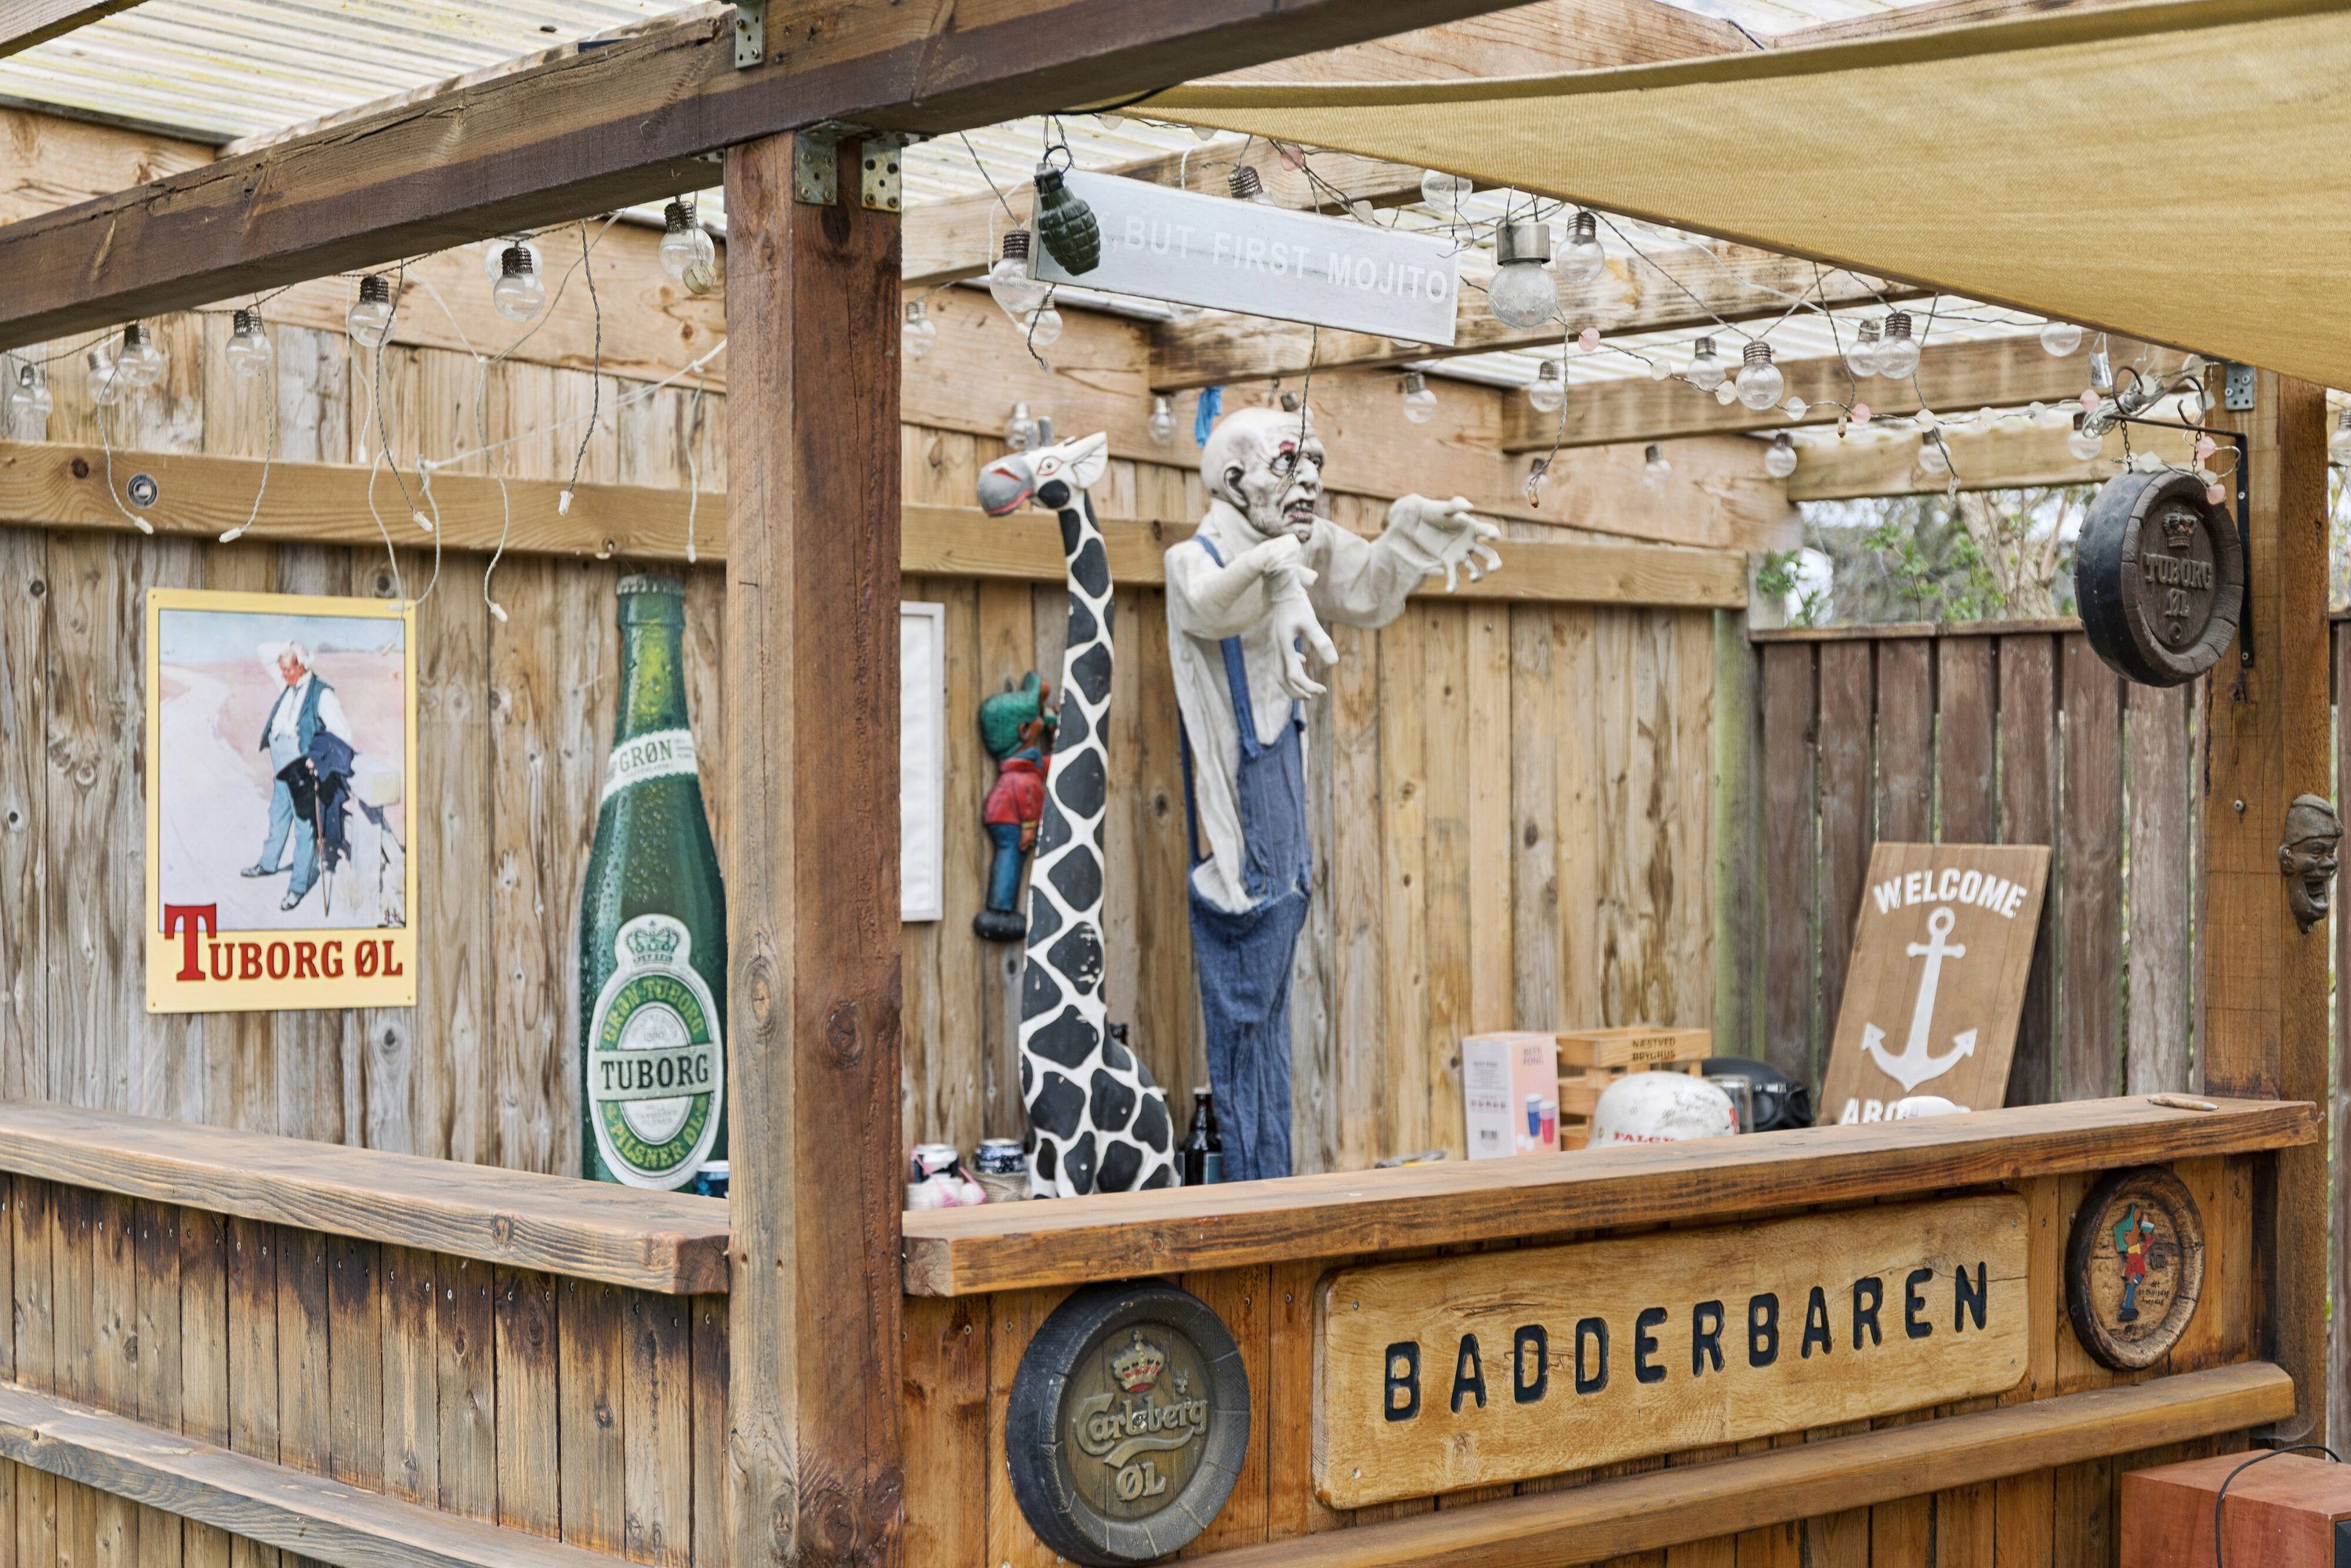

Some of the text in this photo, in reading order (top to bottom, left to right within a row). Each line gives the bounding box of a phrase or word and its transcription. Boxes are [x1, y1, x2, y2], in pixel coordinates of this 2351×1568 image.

[1125, 215, 1195, 259] BUT
[1213, 231, 1310, 280] FIRST
[1328, 251, 1448, 303] MOJITO
[2143, 552, 2213, 590] TUBORG
[2164, 588, 2191, 618] ØL
[619, 739, 672, 773] GRØN
[1872, 867, 2028, 919] WELCOME
[164, 902, 403, 981] TUBORG ØL
[603, 979, 705, 1043] GRØN TUBORG
[601, 1053, 709, 1091] TUBORG
[610, 1120, 686, 1168] PILSNER
[1382, 1259, 1989, 1424] BADDERBAREN
[1114, 1461, 1168, 1502] ØL
